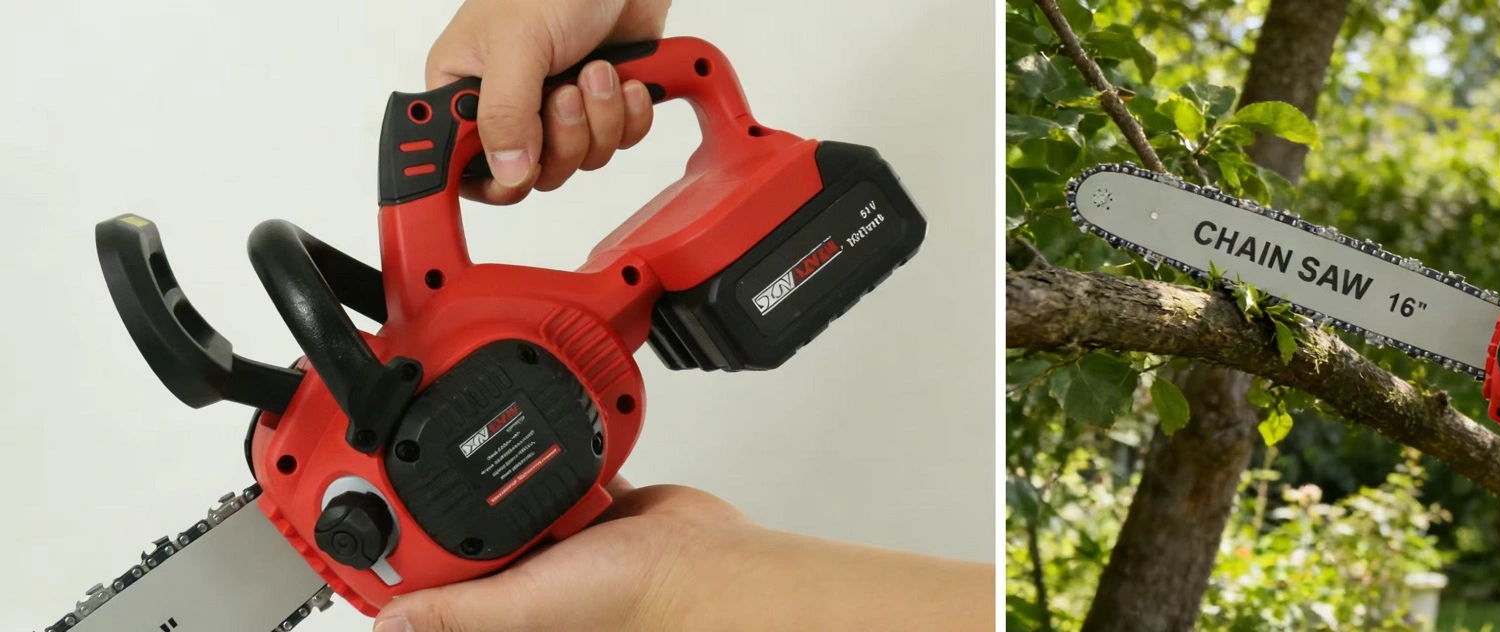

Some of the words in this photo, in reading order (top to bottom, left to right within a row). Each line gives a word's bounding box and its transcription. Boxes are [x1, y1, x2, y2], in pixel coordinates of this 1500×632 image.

[1193, 220, 1293, 273] CHAIN
[1298, 256, 1374, 300] SAW
[1389, 292, 1427, 318] 16"
